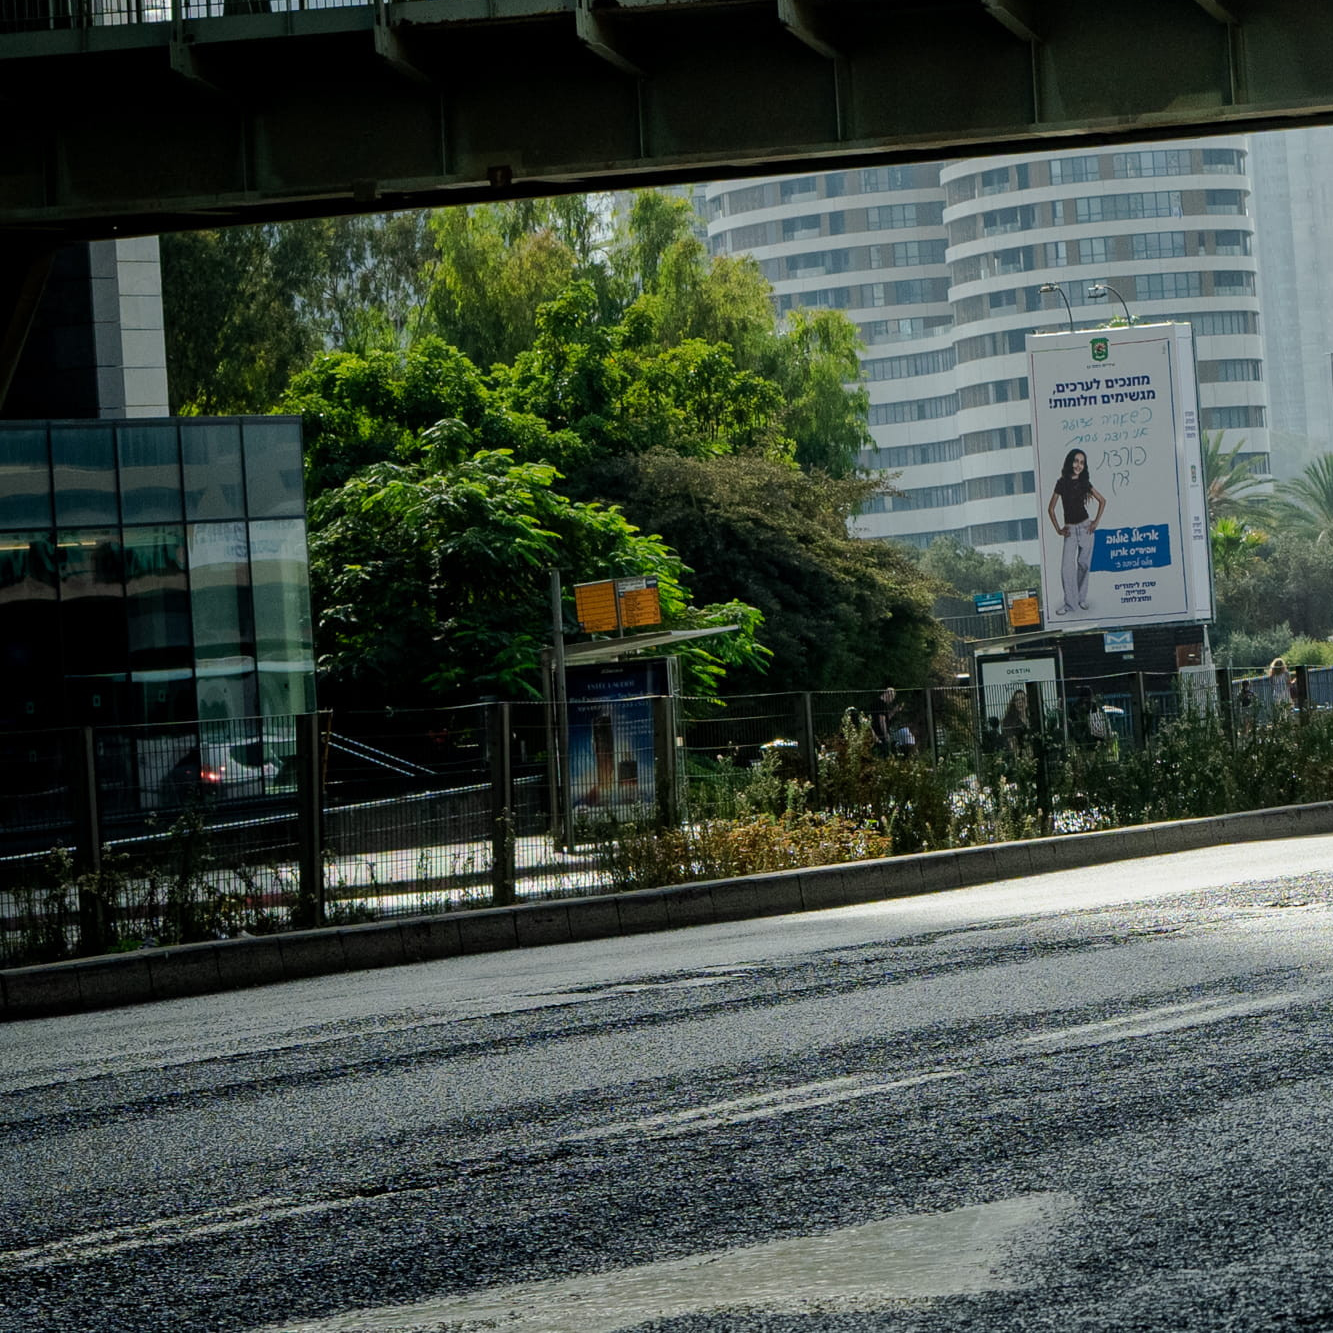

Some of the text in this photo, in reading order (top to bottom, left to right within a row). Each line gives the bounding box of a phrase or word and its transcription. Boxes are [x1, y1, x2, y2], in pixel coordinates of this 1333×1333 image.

[1104, 375, 1151, 389] מחנכים
[1048, 389, 1156, 409] מגשימים חלומות!
[1103, 431, 1129, 442] רוצה
[1096, 446, 1147, 471] פורצת
[1131, 528, 1159, 542] אריאל
